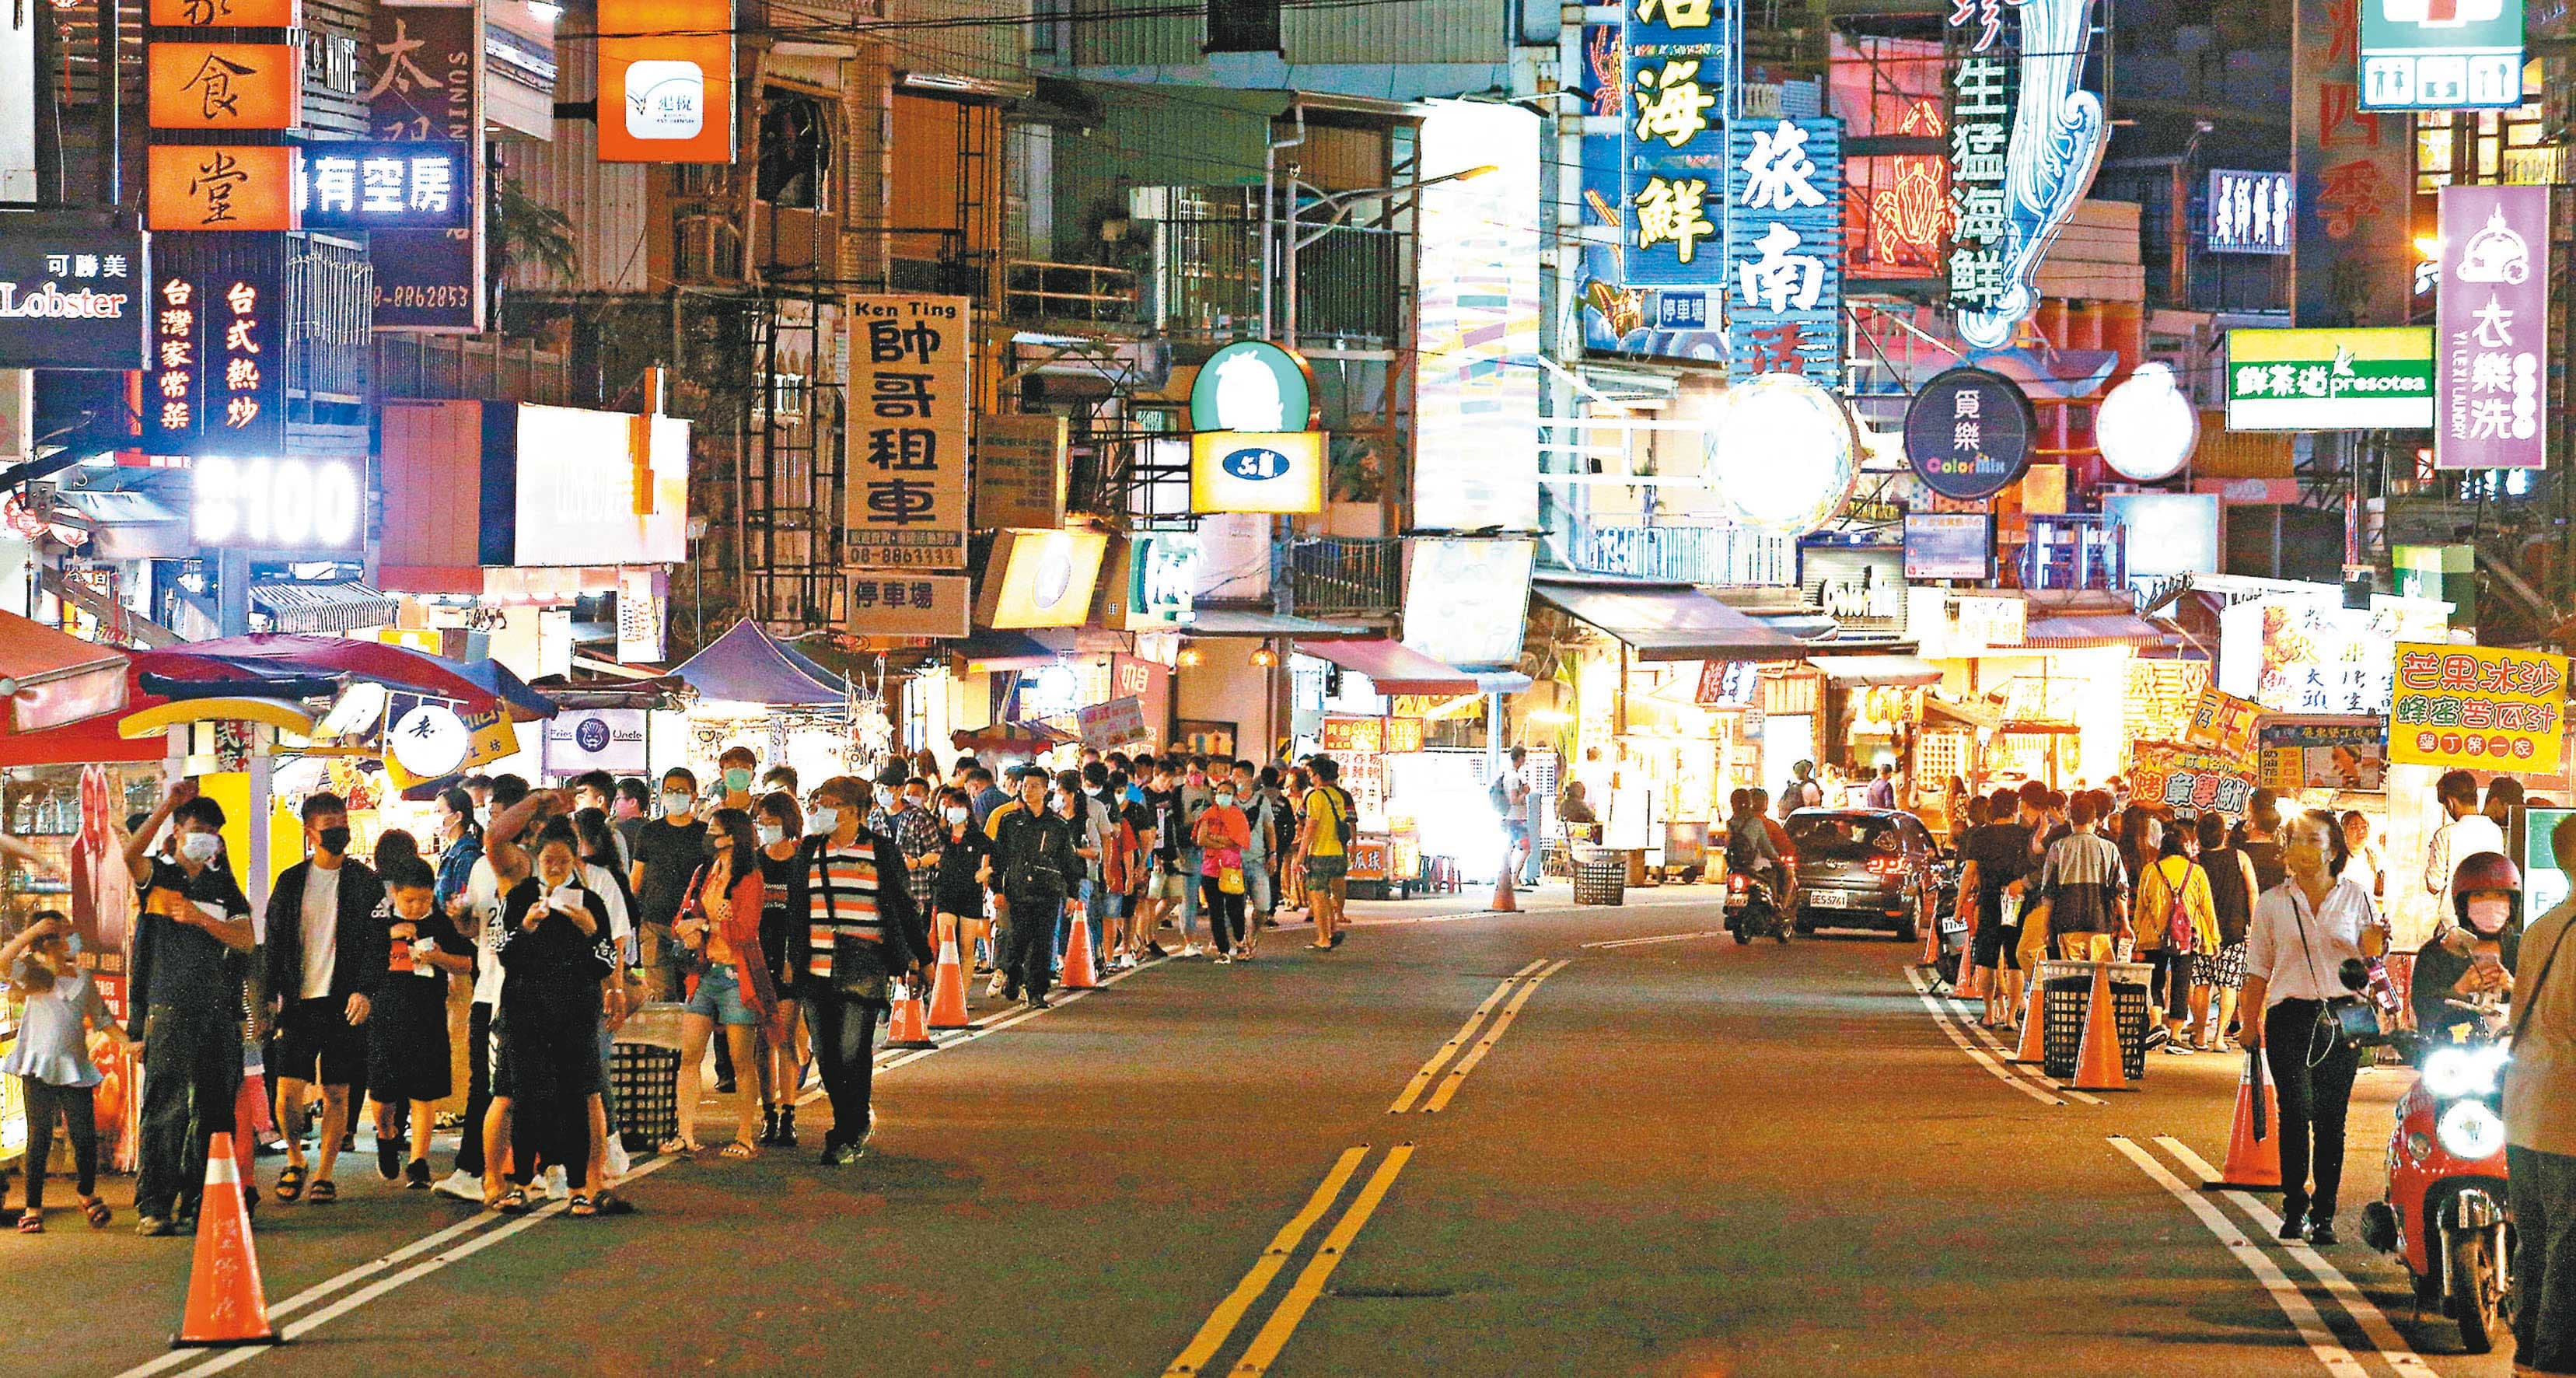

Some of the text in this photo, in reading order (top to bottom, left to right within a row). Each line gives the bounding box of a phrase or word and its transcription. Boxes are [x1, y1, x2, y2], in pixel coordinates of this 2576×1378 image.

[300, 155, 451, 213] 有空房
[1948, 58, 2007, 309] 生猛海鮮
[46, 254, 128, 278] 可勝美
[0, 282, 127, 318] Lobster
[855, 302, 957, 318] Ken Ting
[1662, 299, 1704, 322] 停車場
[160, 278, 193, 430] 台灣家常菜
[225, 282, 260, 428] 台式熱炒
[2470, 292, 2513, 440] 衣樂洗
[2235, 365, 2327, 397] 鮮茶道
[866, 319, 942, 525] 帥哥租車
[855, 580, 932, 609] 停車場
[2403, 652, 2560, 696] 芒果冰沙
[2396, 694, 2558, 733] 蜂蜜苦瓜汁
[2417, 731, 2534, 758] 墾丁第一家
